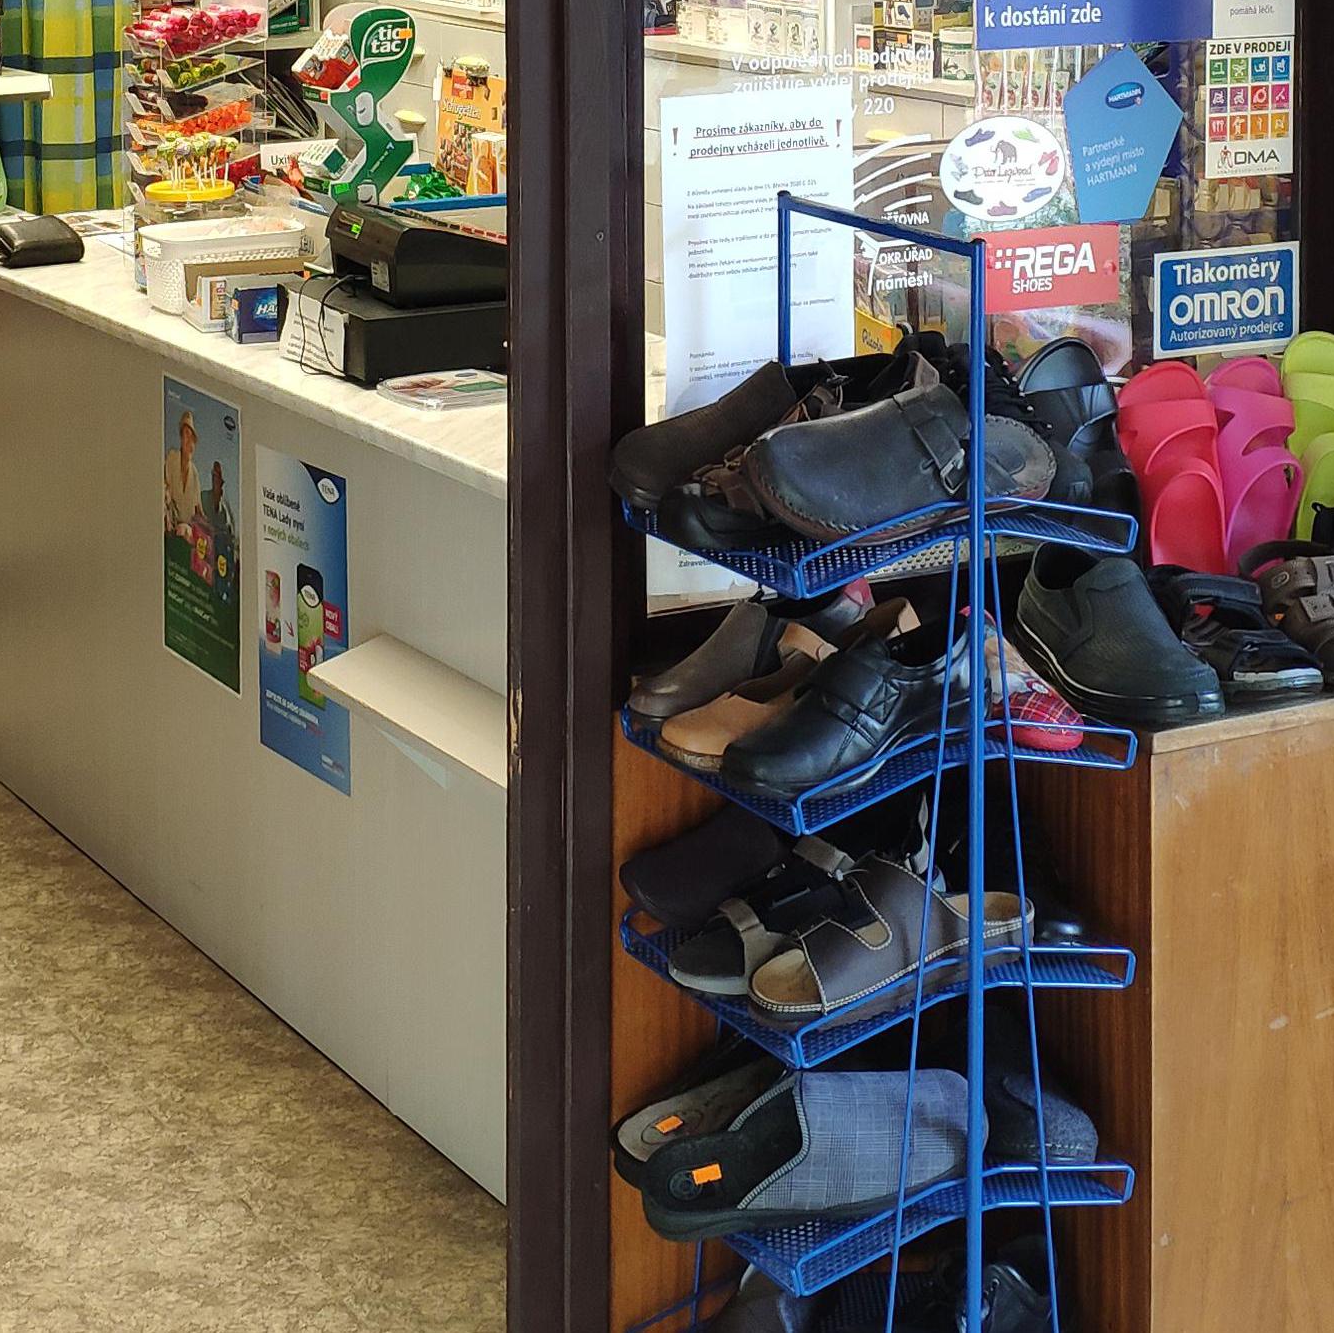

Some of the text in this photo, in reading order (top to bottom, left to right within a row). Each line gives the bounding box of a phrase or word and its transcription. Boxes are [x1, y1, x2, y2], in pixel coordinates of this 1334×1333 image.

[984, 1, 1102, 29] k dostání zde
[1229, 5, 1257, 17] pomáhá
[371, 39, 401, 54] tac
[1210, 41, 1291, 55] ZDE V PRODEJI
[731, 55, 744, 71] V
[1109, 87, 1142, 103] HARTMANN
[864, 97, 895, 115] 220
[695, 117, 822, 138] Prosíme zákazníky, aby do
[689, 144, 734, 159] prodejny
[737, 140, 775, 156] vcházeli
[1082, 137, 1126, 156] Partnerské
[1091, 155, 1121, 173] výdejní
[1122, 147, 1145, 161] místo
[1087, 164, 1137, 187] HARTMANN
[1013, 242, 1096, 280] REGA
[876, 271, 933, 290] náměstí
[1173, 257, 1281, 286] Tlakoměry
[1012, 277, 1053, 294] SHOES
[1169, 286, 1285, 326] OMRON
[1169, 321, 1284, 343] Autorizovaný prodejce
[263, 504, 278, 520] TENA
